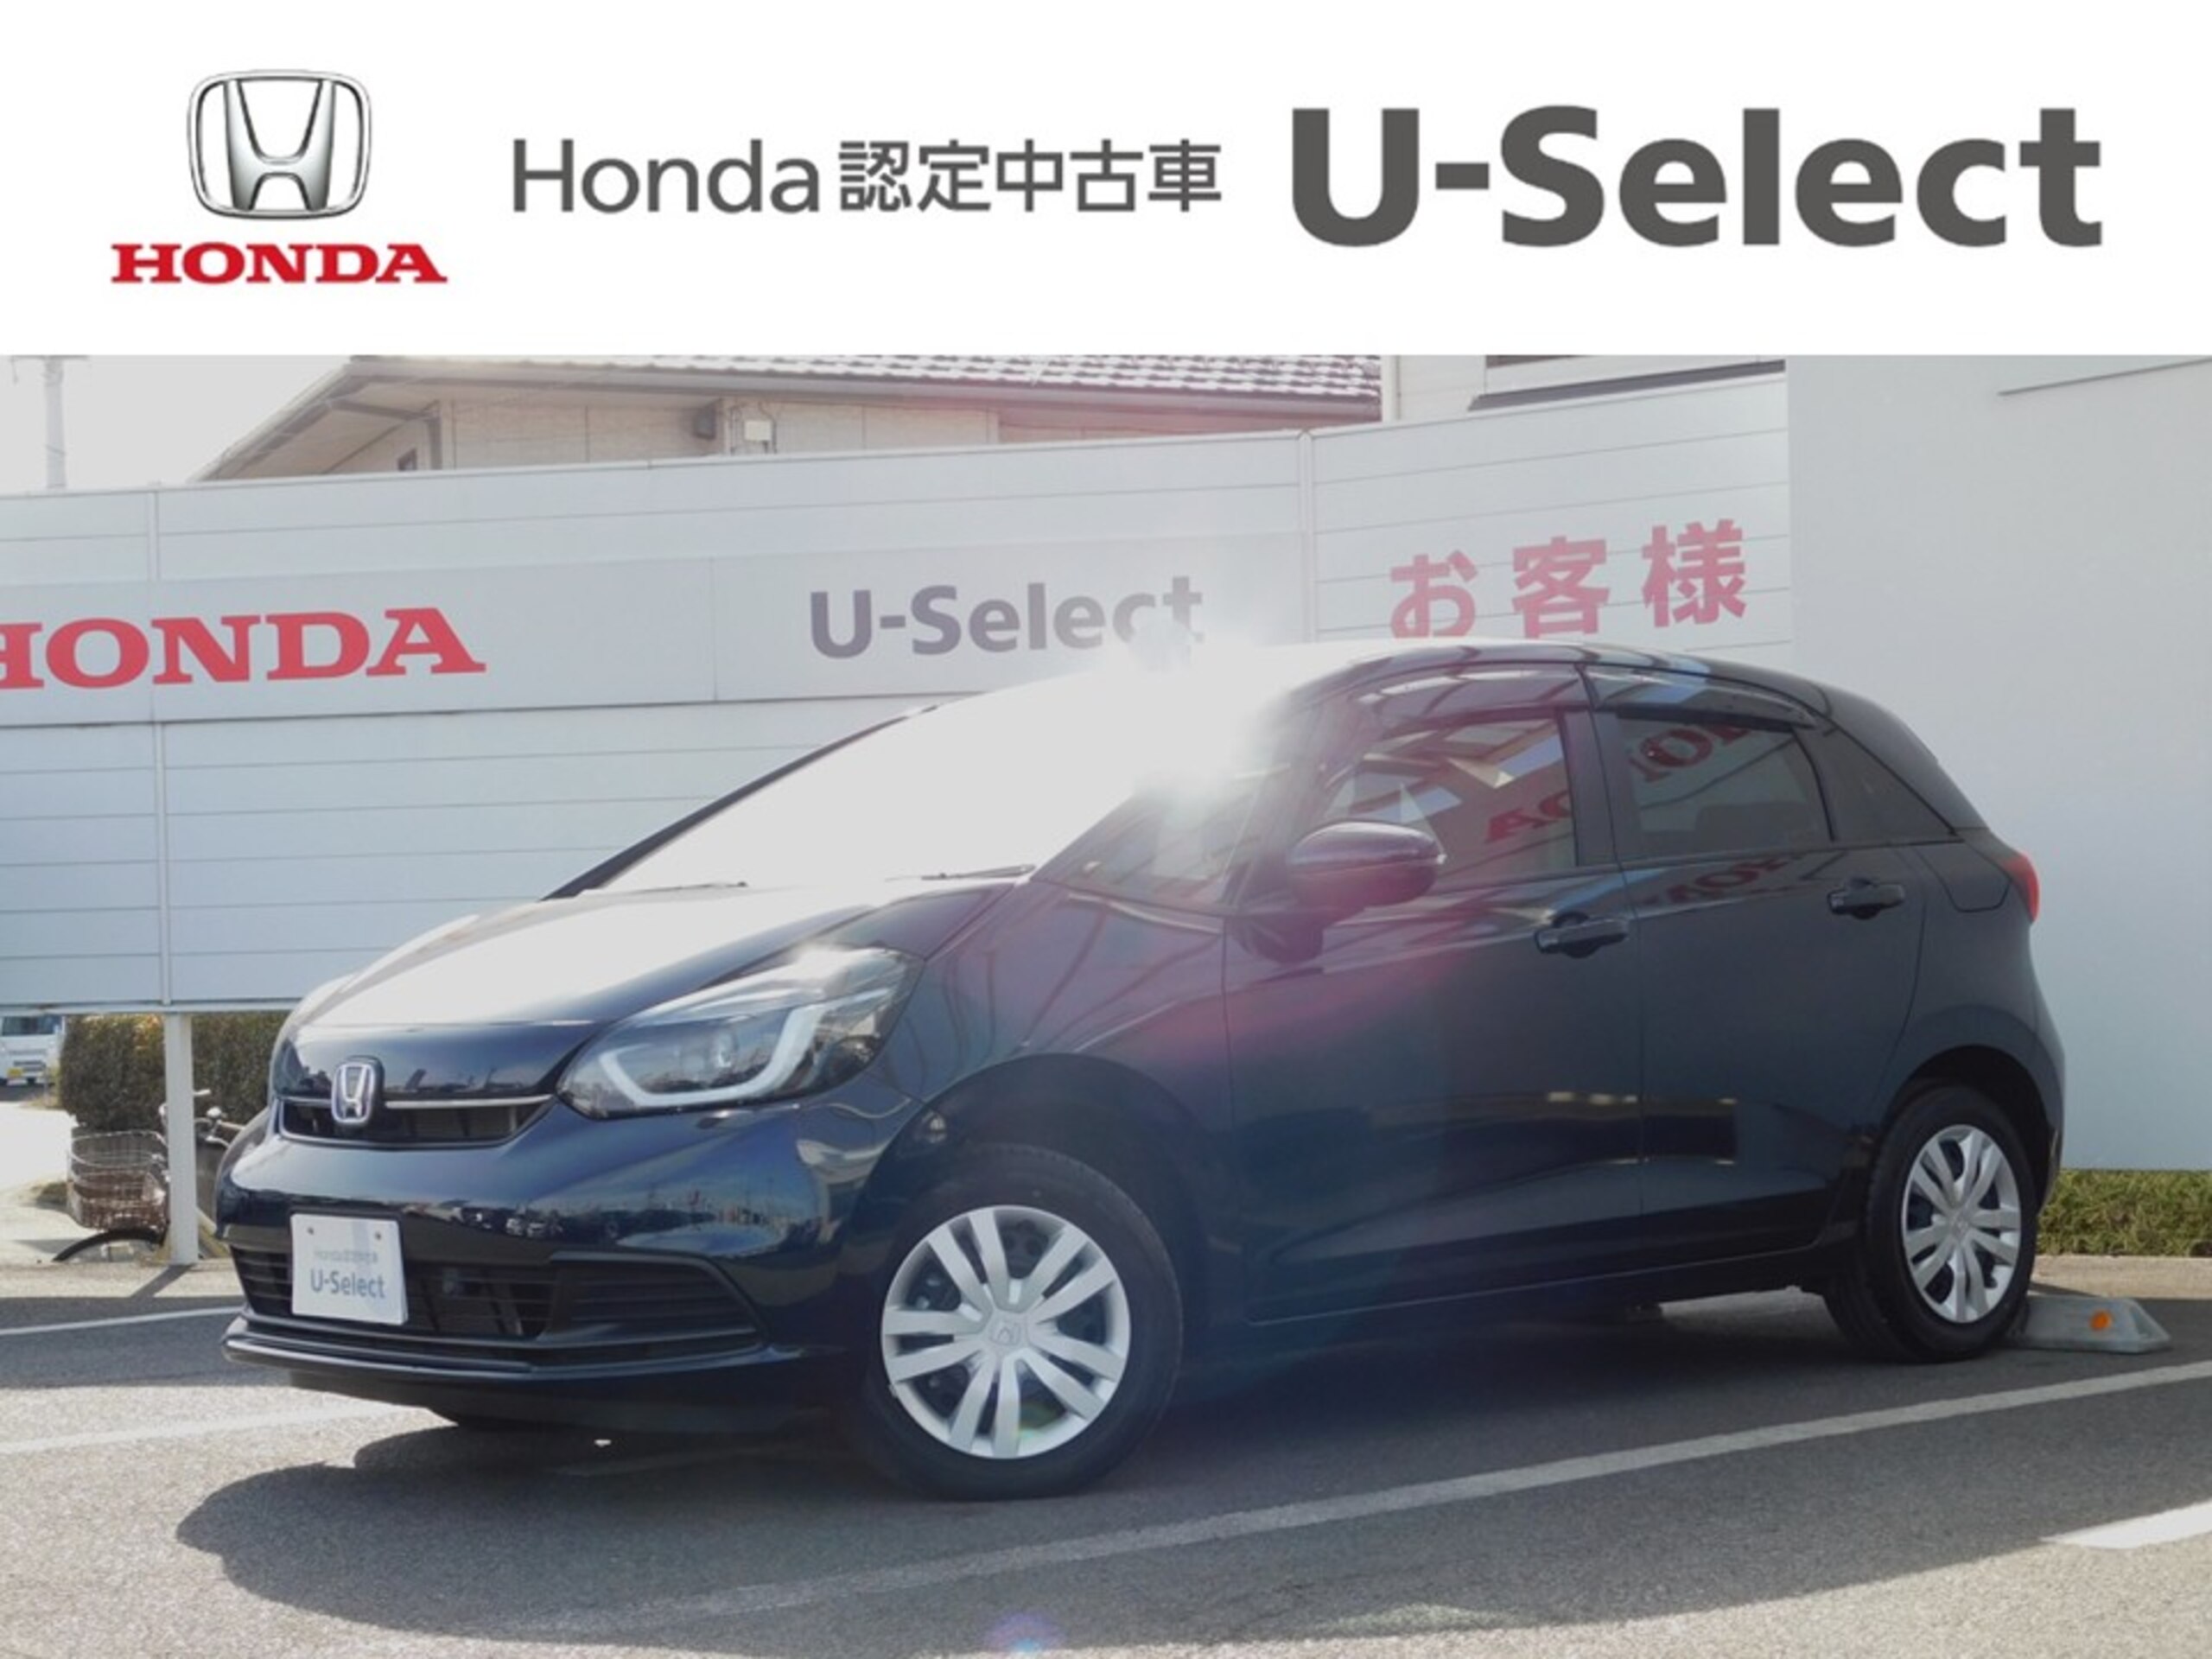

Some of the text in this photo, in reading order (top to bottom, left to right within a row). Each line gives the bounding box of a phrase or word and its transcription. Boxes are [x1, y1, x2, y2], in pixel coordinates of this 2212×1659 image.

[1389, 518, 1747, 639] お客様
[310, 1268, 386, 1299] U-Select
